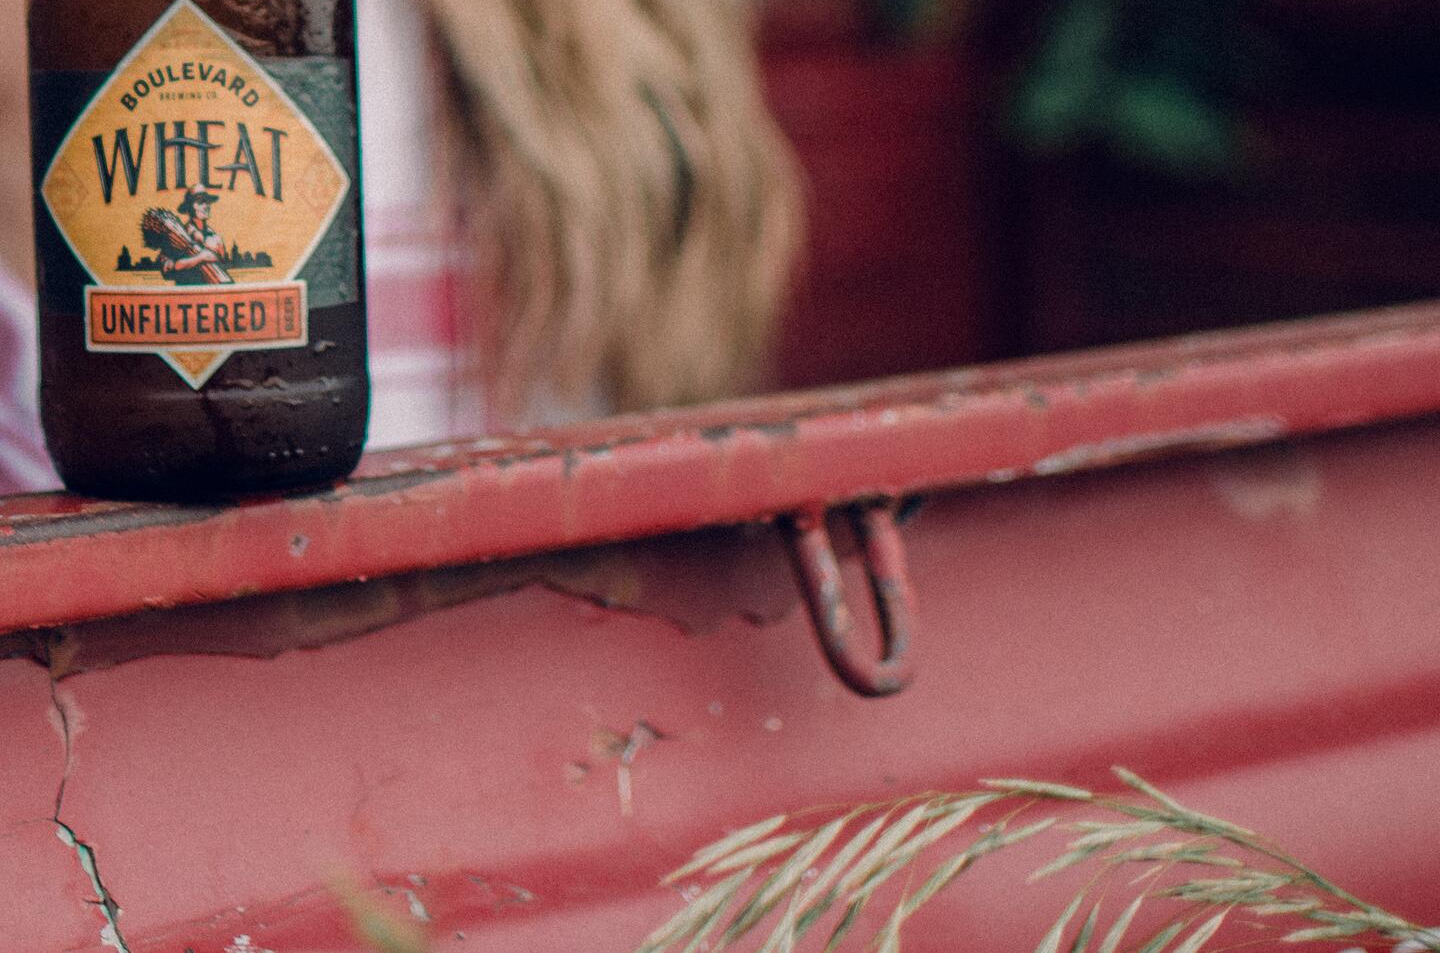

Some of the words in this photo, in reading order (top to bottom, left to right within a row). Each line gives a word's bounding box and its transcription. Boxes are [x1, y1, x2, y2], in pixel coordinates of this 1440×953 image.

[120, 61, 260, 112] BOULEVARD
[92, 120, 288, 204] WHEAT
[101, 300, 267, 337] UNFILTERED
[285, 296, 294, 332] BEER
